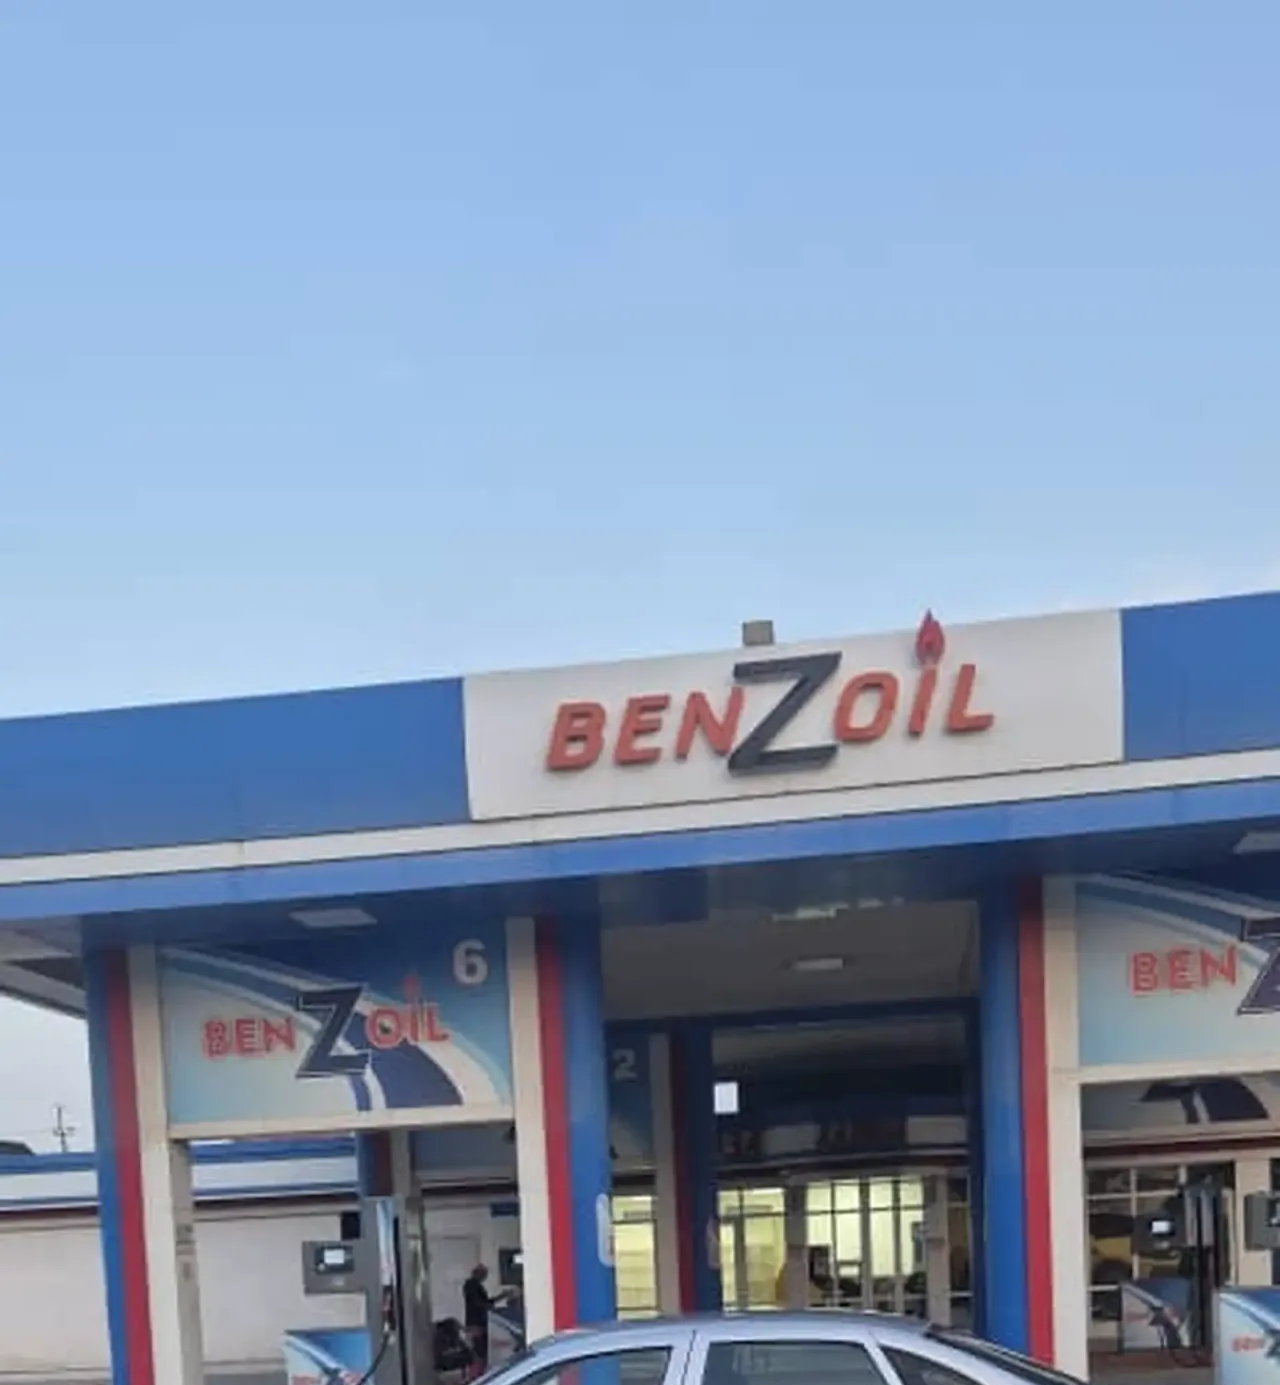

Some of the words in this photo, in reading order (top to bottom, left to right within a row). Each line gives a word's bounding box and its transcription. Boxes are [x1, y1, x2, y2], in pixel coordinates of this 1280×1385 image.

[545, 650, 995, 776] BENZOIL
[453, 939, 489, 985] 6
[203, 980, 450, 1079] BENZOIL
[612, 1049, 637, 1080] 2
